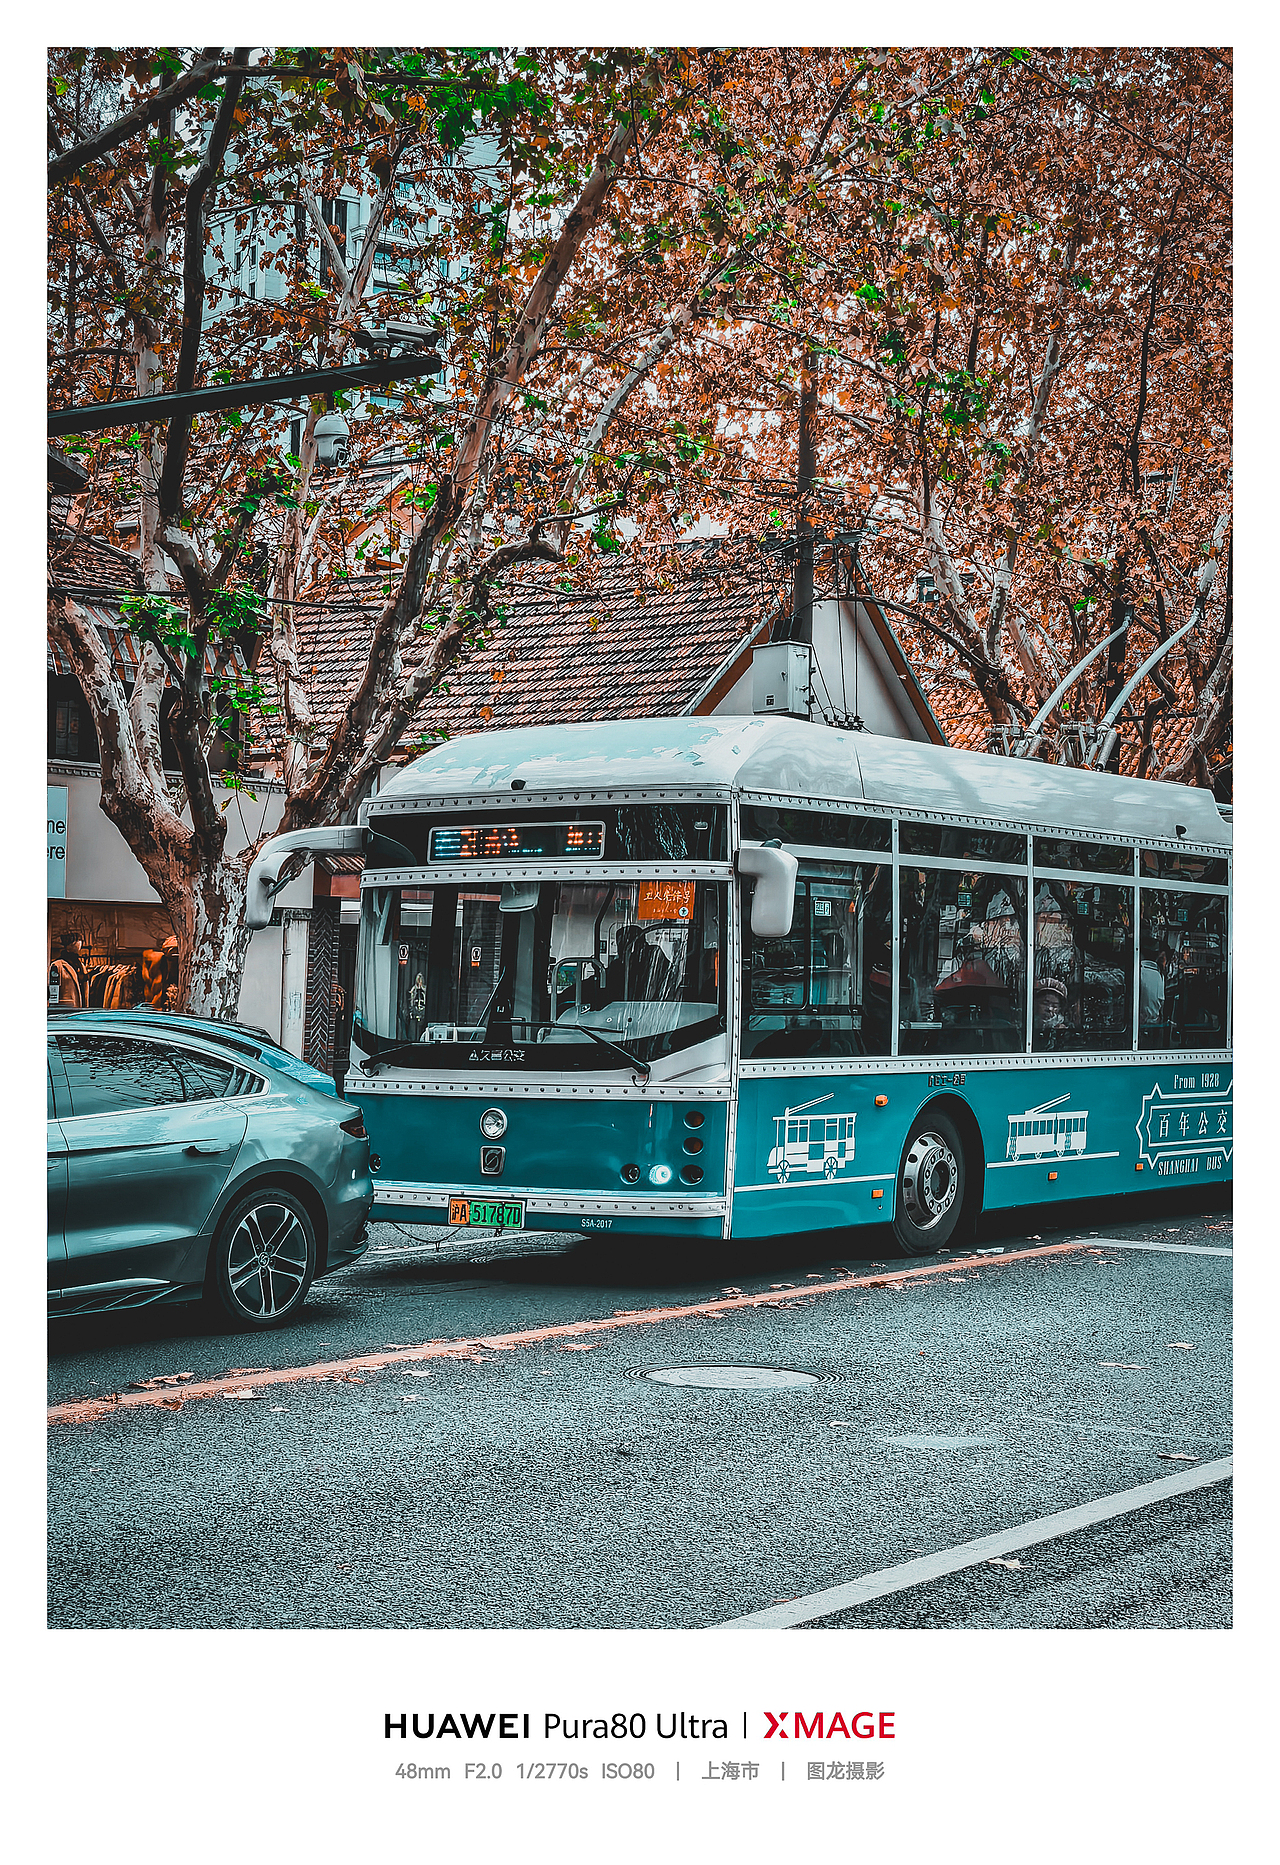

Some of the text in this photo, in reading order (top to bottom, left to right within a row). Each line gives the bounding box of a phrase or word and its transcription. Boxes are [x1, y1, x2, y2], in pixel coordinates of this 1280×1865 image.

[47, 846, 66, 860] re
[1173, 1073, 1220, 1090] From 1928
[1158, 1108, 1228, 1138] 百年公交
[1158, 1155, 1223, 1176] SHANGHAI BUS
